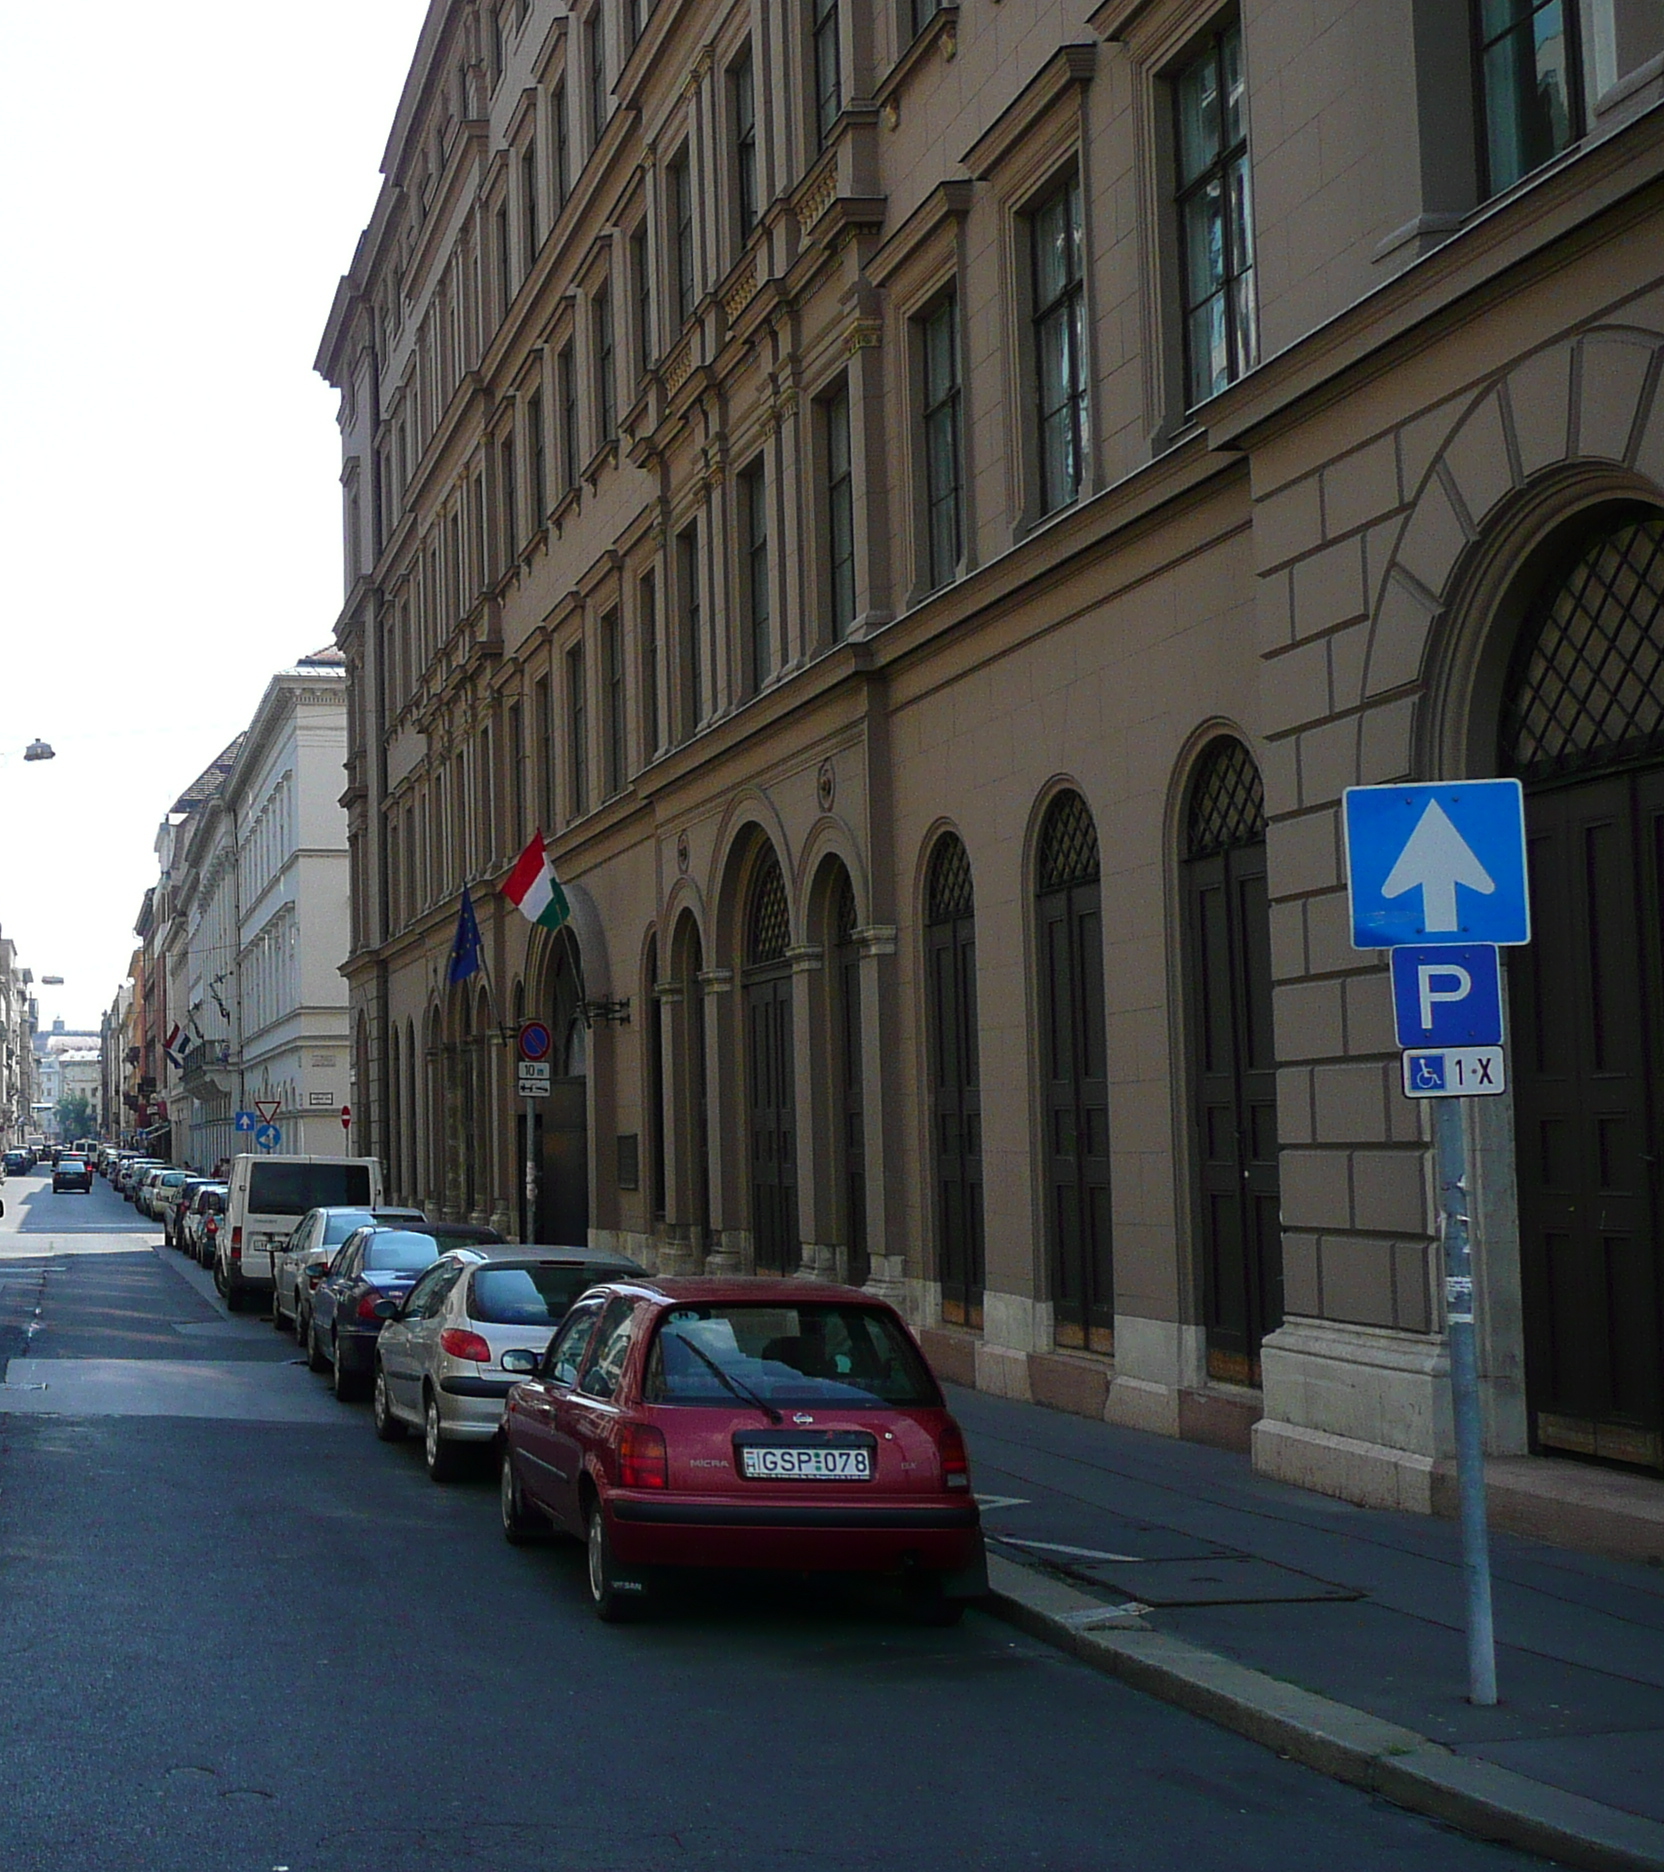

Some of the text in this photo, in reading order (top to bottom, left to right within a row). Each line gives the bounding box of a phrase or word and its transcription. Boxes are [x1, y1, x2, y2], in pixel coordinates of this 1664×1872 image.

[1418, 964, 1472, 1030] P
[524, 1064, 535, 1077] 10
[690, 1458, 729, 1468] MICRA
[762, 1451, 867, 1473] GSP-078
